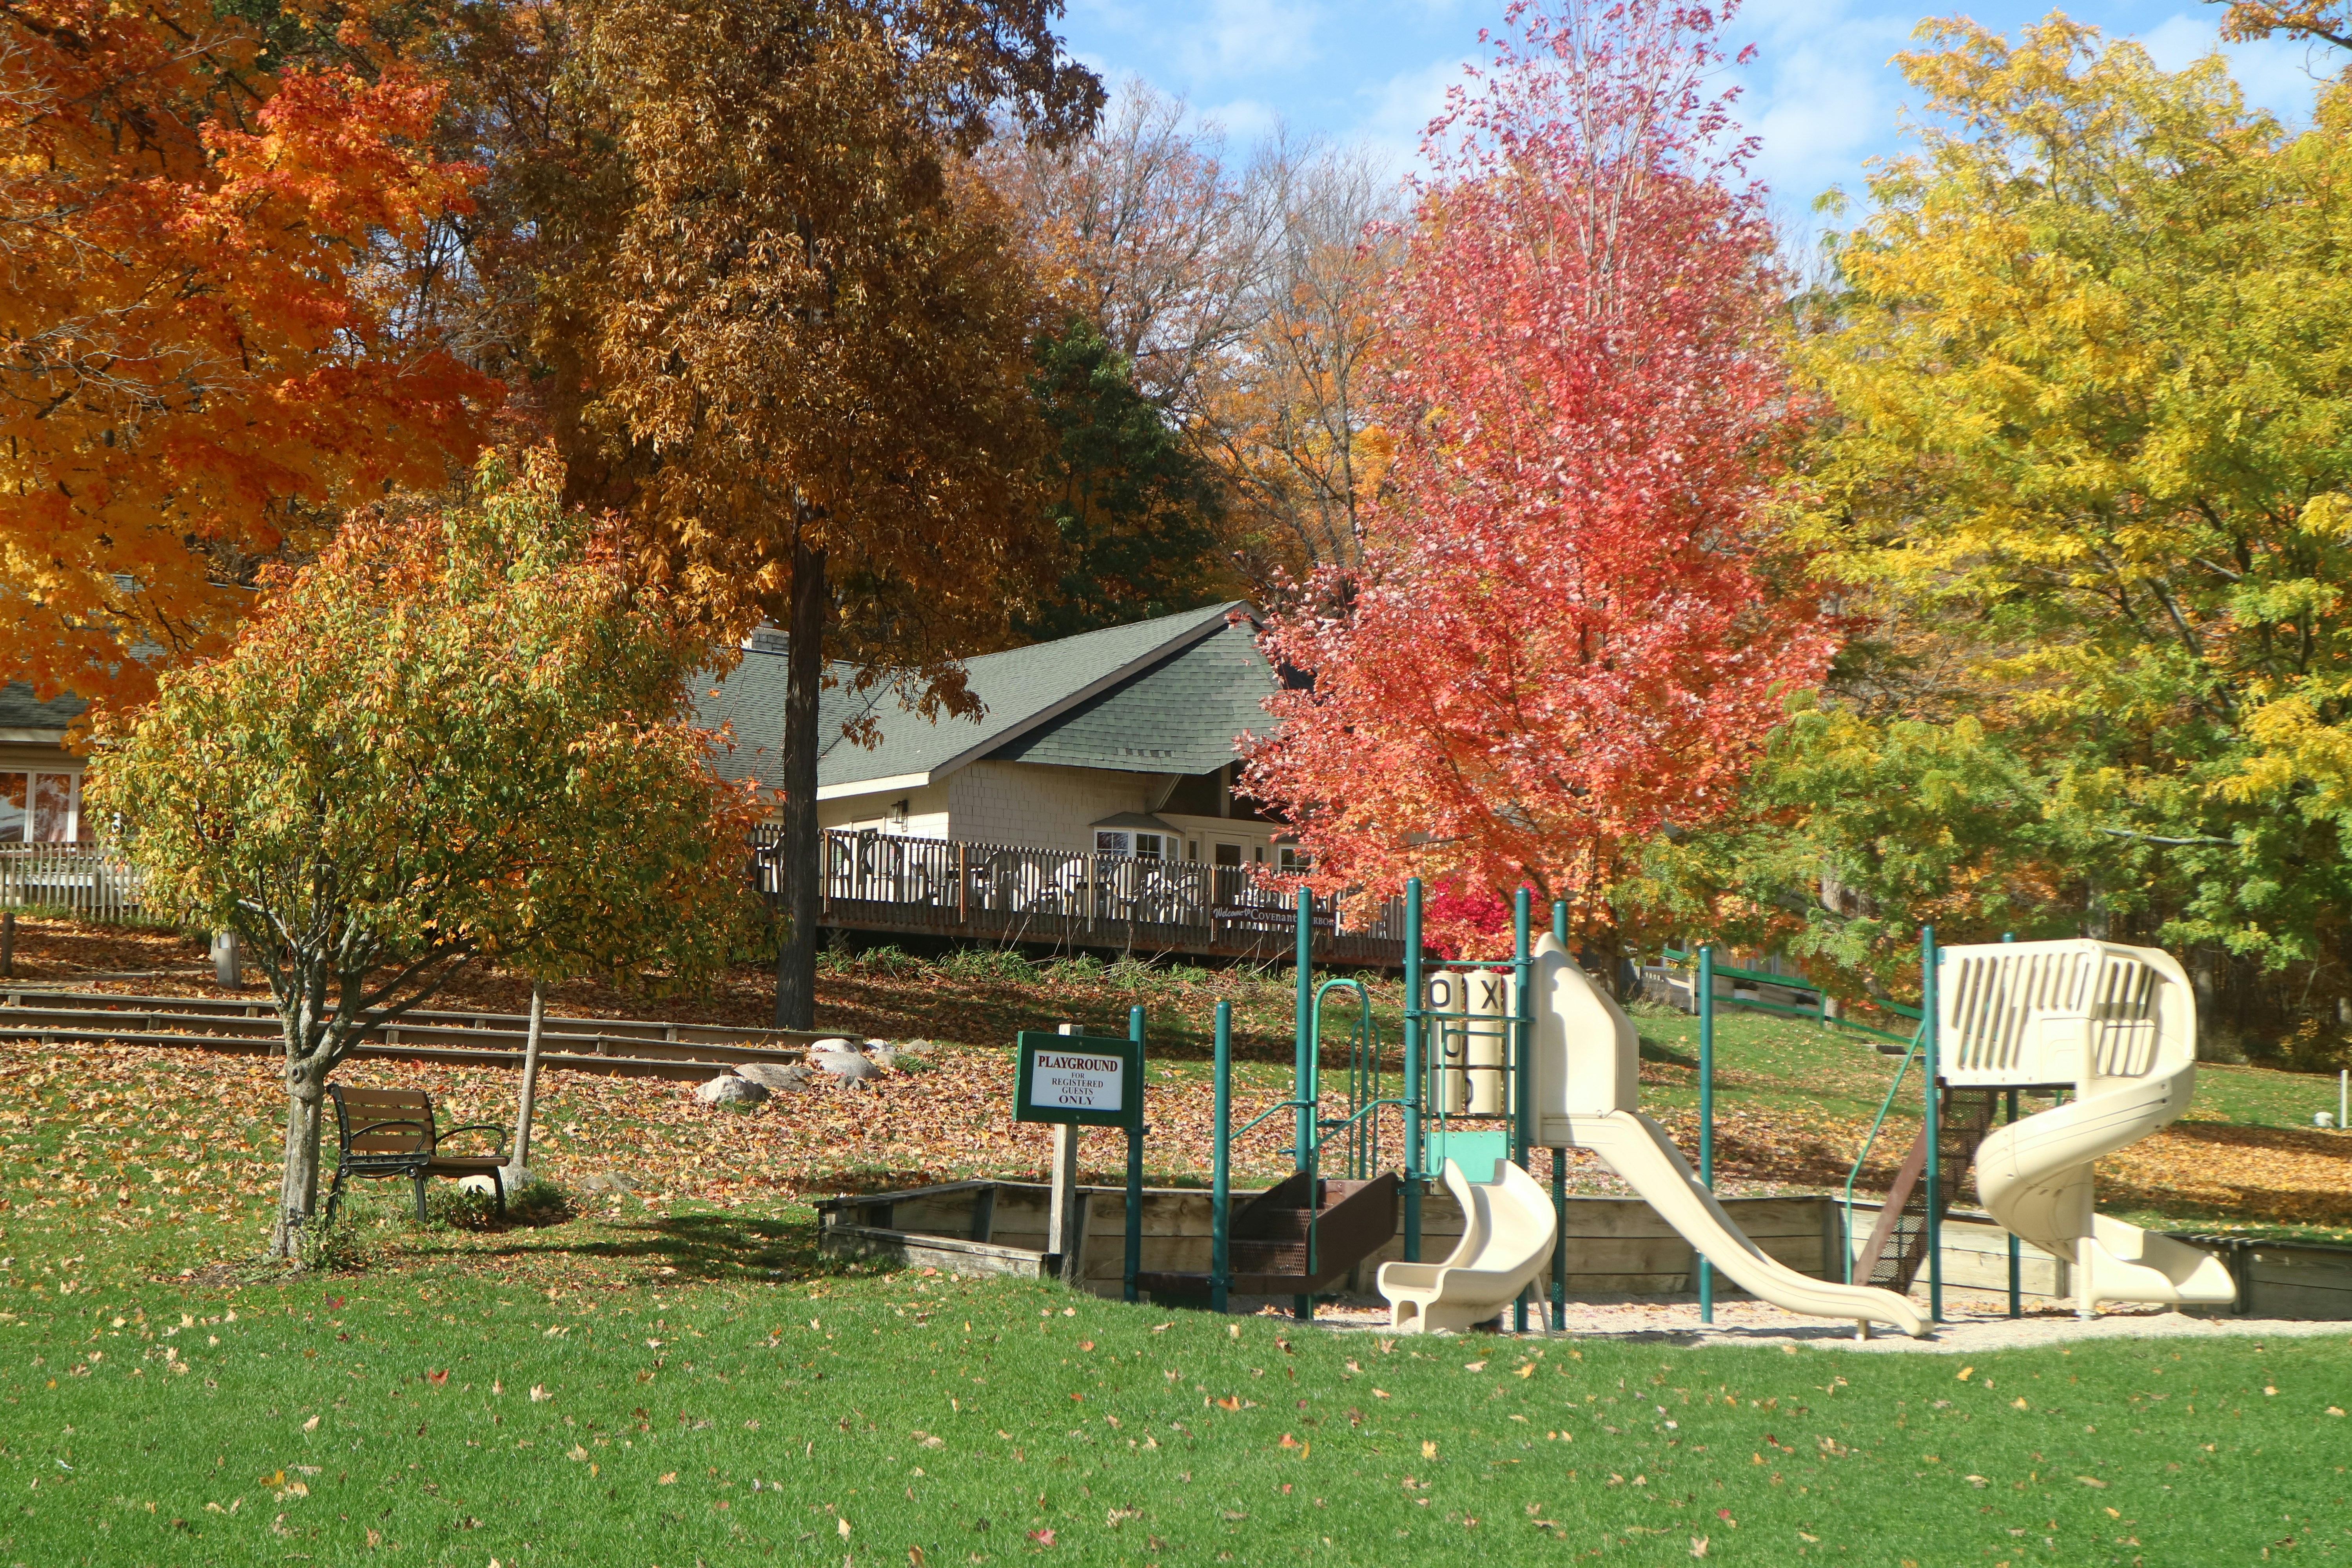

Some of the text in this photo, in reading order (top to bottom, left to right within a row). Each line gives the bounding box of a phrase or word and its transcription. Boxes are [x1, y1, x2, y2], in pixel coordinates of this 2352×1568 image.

[1213, 907, 1244, 918] Welcome
[1244, 907, 1250, 916] to
[1313, 917, 1334, 926] RBOR
[1038, 1055, 1118, 1072] PLAYGROUND
[1052, 1078, 1103, 1088] REGISTERED
[1062, 1087, 1093, 1095] GUESTS
[1059, 1095, 1095, 1105] ONLY
